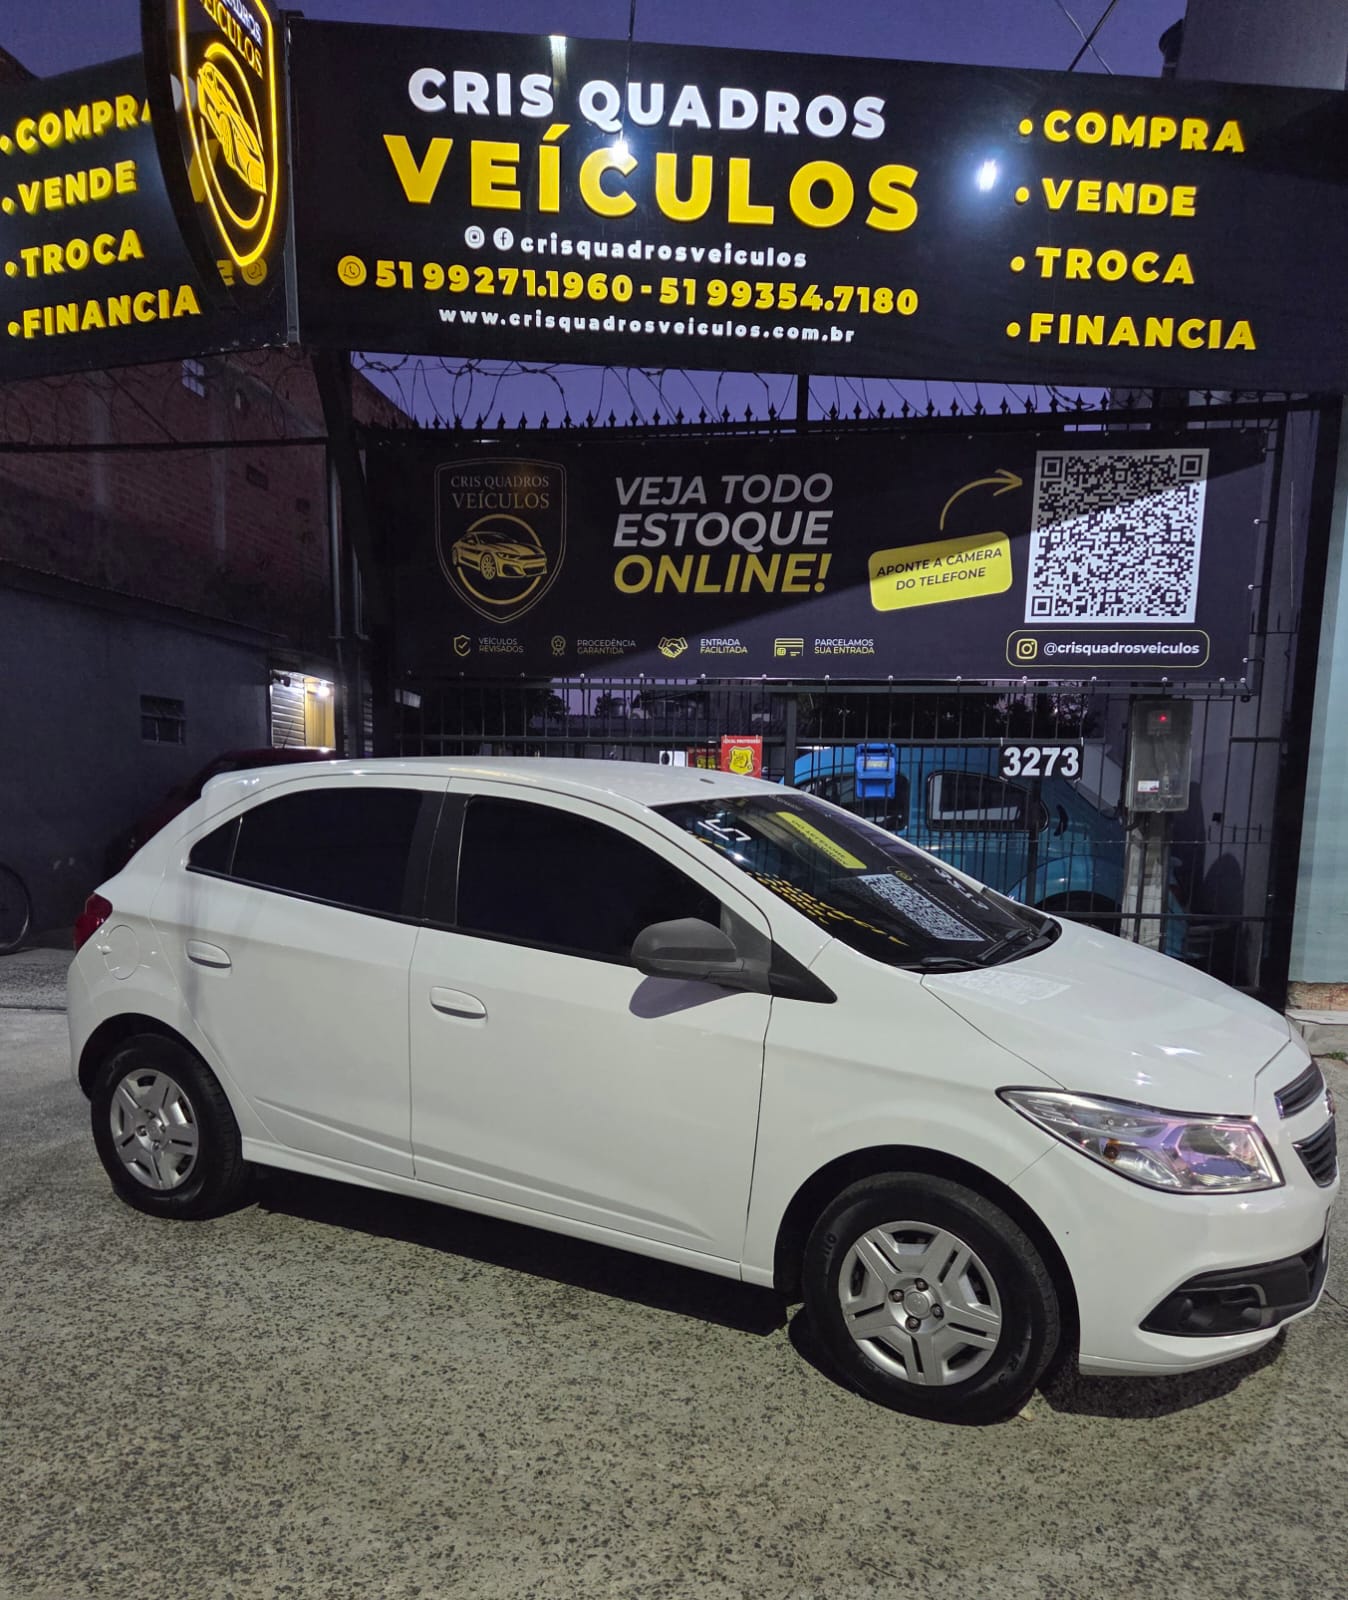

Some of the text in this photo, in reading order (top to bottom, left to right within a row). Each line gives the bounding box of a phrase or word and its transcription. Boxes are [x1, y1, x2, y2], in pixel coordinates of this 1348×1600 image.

[408, 67, 886, 140] CRIS QUADROS
[1043, 109, 1246, 153] COMPRA
[17, 159, 137, 214] VENDE
[383, 123, 919, 233] VEÍCULOS
[1041, 177, 1198, 217] VENDE
[20, 228, 144, 278] TROCA
[520, 232, 807, 268] crisquadrosveiculos
[1035, 246, 1195, 285] TROCA
[375, 259, 414, 289] 51
[422, 262, 634, 303] 99271.1960
[659, 277, 697, 306] 51
[706, 279, 919, 316] 99354.7180
[23, 284, 201, 338] FINANCIA
[438, 308, 855, 343] www.crisquadrosveiculos.com.br
[1029, 312, 1257, 350] FINANCIA
[450, 475, 549, 490] CRIS QUADROS
[451, 489, 550, 510] VEÍCULOS
[615, 472, 833, 506] VEJA TODO
[612, 510, 834, 553] ESTOQUE
[613, 553, 833, 594] ONLINE!
[876, 547, 1003, 577] APONTE A CÂMERA
[896, 566, 987, 591] DO TELEFONE
[576, 637, 637, 649] PROCEDÊNCIA
[700, 638, 741, 647] ENTRADA
[700, 645, 749, 655] FACILITADA
[814, 638, 874, 648] PARCELAMOS
[814, 646, 876, 655] SUA ENTRADA
[1043, 641, 1200, 657] @crisquadrosveiculos
[1003, 746, 1079, 777] 3273
